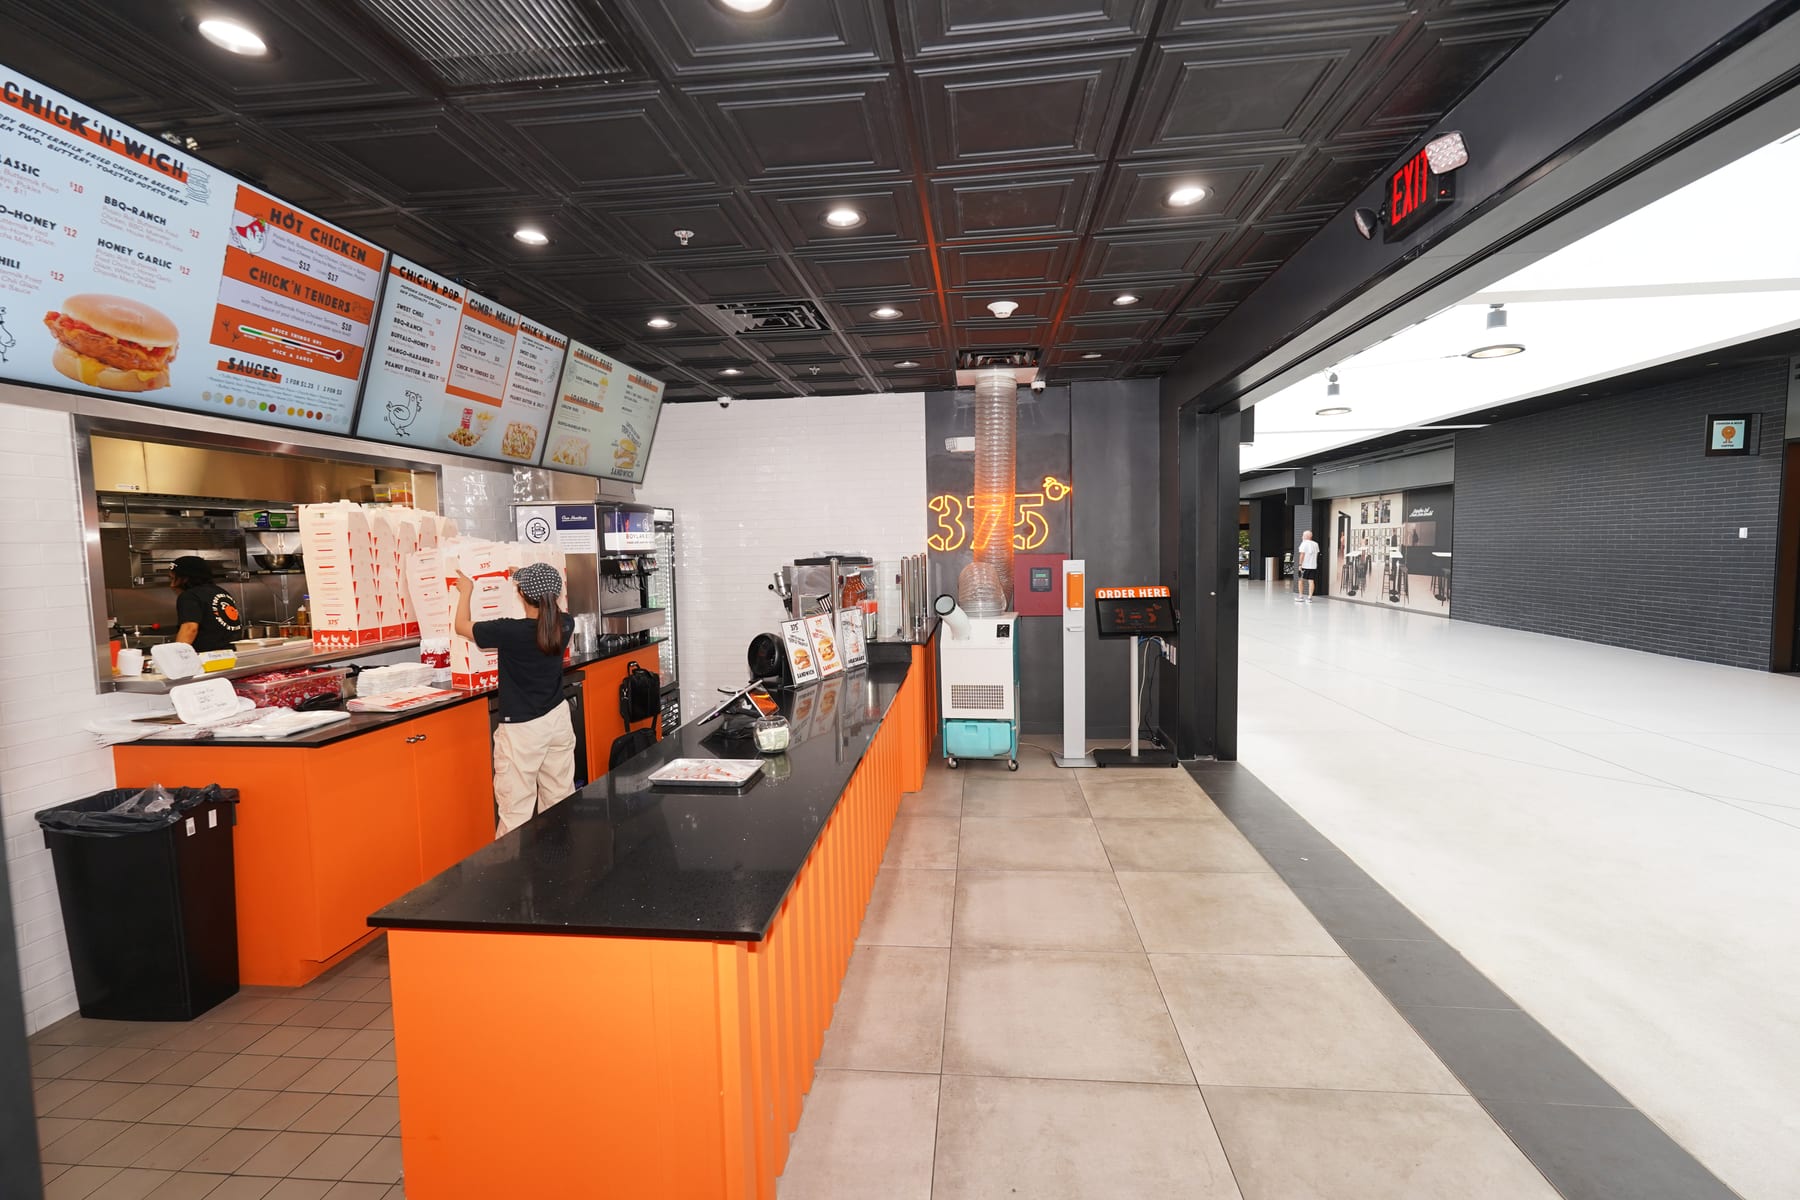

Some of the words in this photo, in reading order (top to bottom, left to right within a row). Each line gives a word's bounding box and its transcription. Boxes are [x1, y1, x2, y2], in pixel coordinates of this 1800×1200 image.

[19, 123, 84, 154] BUTTERMILK
[86, 151, 111, 165] FRIED
[112, 163, 149, 182] CHICKEN
[151, 180, 180, 194] BREAST
[96, 164, 134, 183] TOASTED
[136, 182, 166, 196] POTATO
[168, 195, 190, 206] BUNS
[1391, 150, 1428, 226] EXIT
[104, 196, 166, 226] BBQ-RANCH
[270, 208, 304, 234] HOT
[310, 227, 367, 262] CHICKEN
[97, 238, 133, 256] HONEY
[137, 252, 172, 269] GARLIC
[298, 260, 311, 272] $12
[249, 267, 302, 295] CHICK'N
[304, 287, 351, 313] TENDERS
[327, 272, 339, 282] $17
[442, 285, 460, 300] POP
[227, 357, 278, 380] SAUCES
[1098, 590, 1135, 599] ORDER
[1139, 588, 1167, 598] HERE
